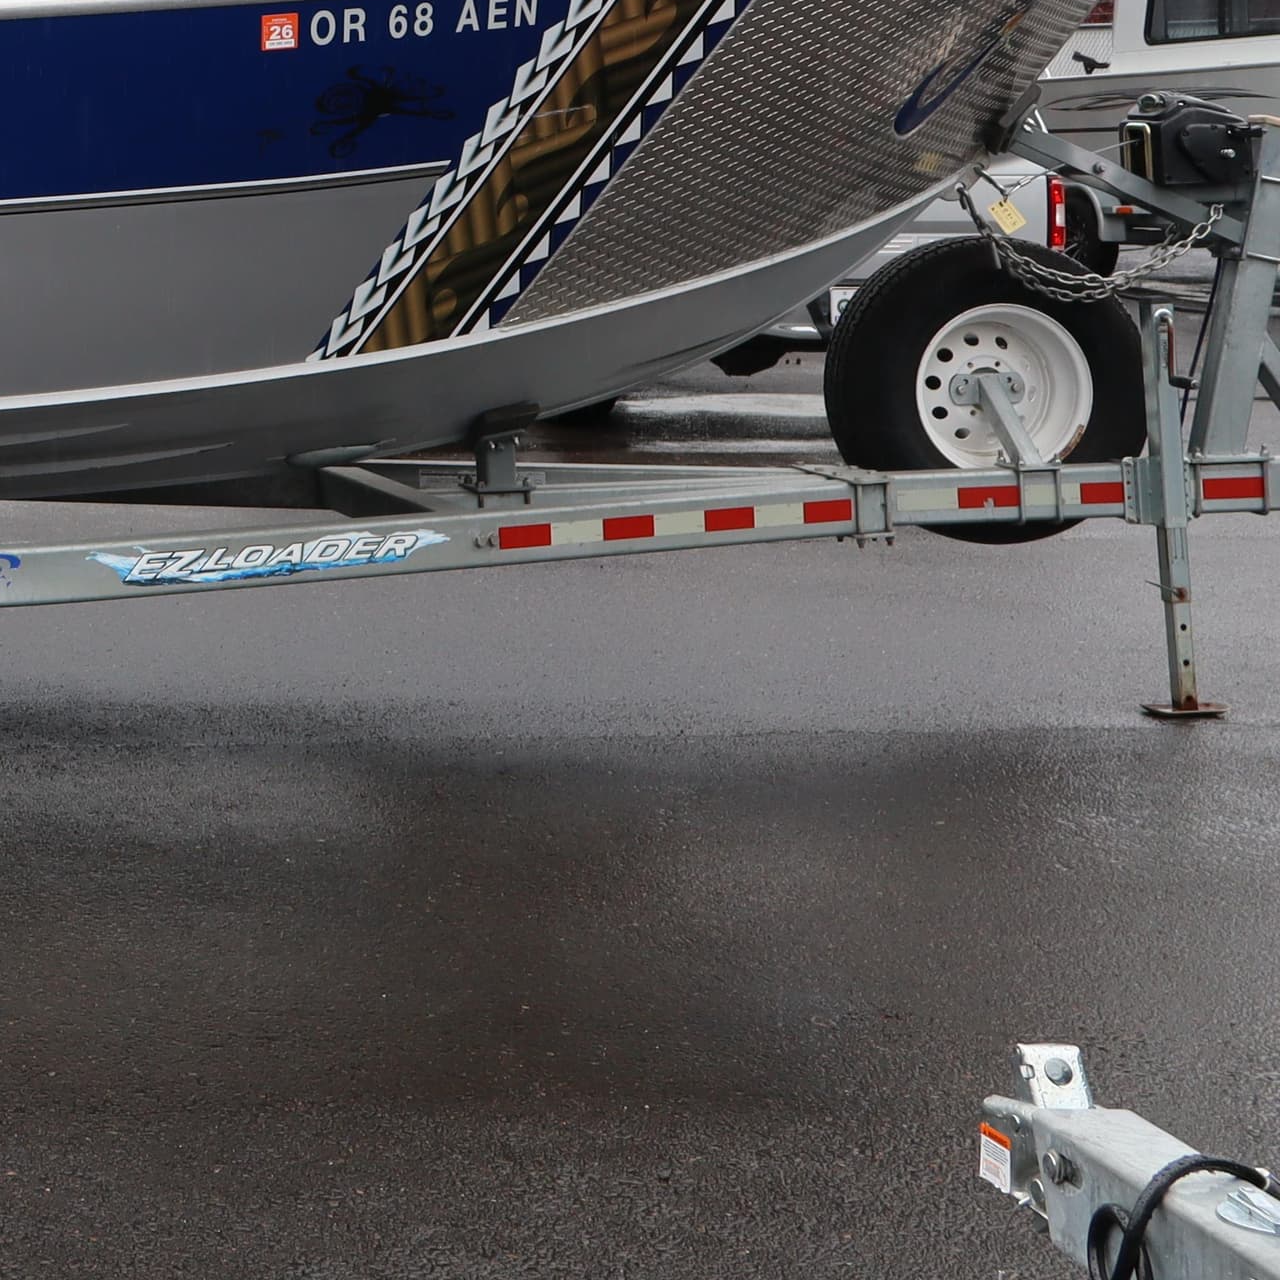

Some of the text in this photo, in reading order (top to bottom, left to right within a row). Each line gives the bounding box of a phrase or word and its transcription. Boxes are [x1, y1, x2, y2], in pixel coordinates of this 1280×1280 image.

[269, 24, 295, 41] 26
[309, 7, 367, 47] OR
[388, 1, 435, 40] 68
